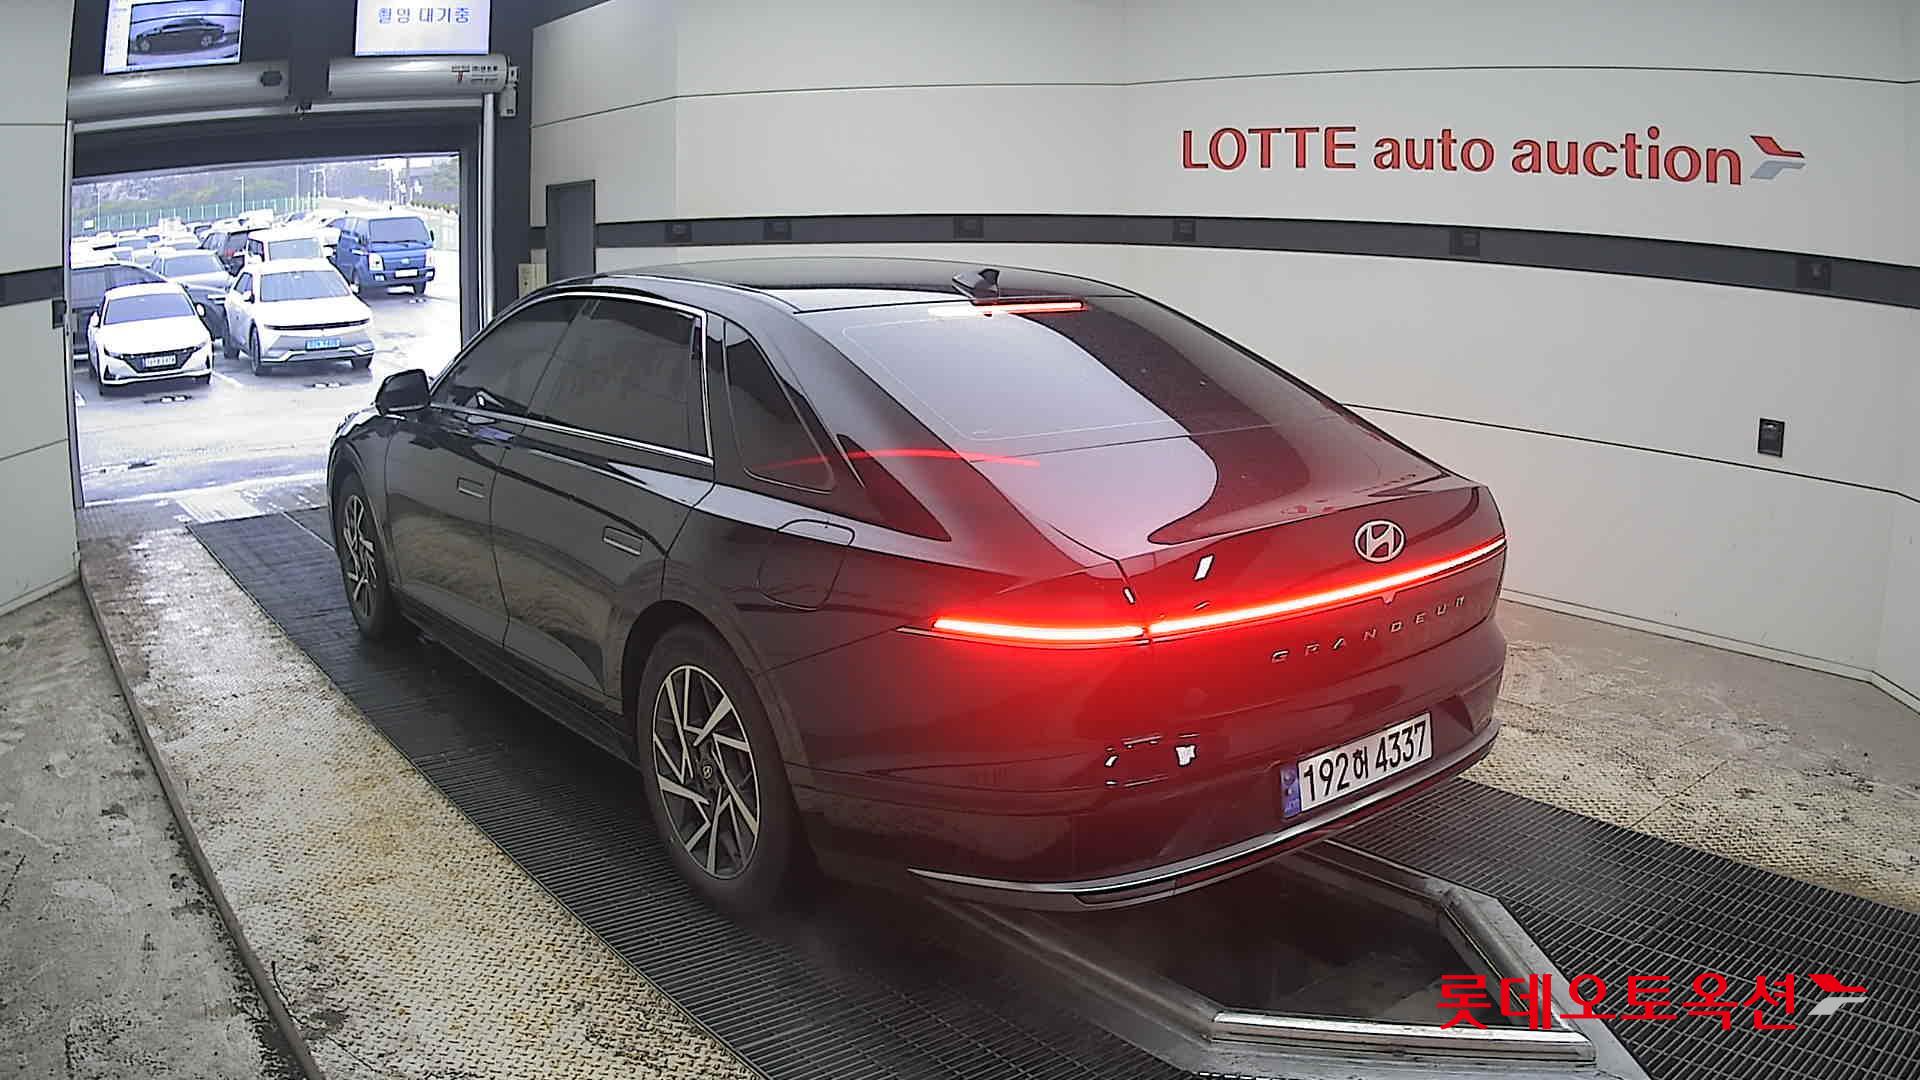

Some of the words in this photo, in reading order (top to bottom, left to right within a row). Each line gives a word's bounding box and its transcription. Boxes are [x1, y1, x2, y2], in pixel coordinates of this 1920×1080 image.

[1182, 126, 1357, 170] LOTTE
[1373, 128, 1496, 172] auto
[1511, 126, 1742, 185] auction
[1303, 746, 1369, 802] 192허
[1375, 720, 1426, 772] 4337
